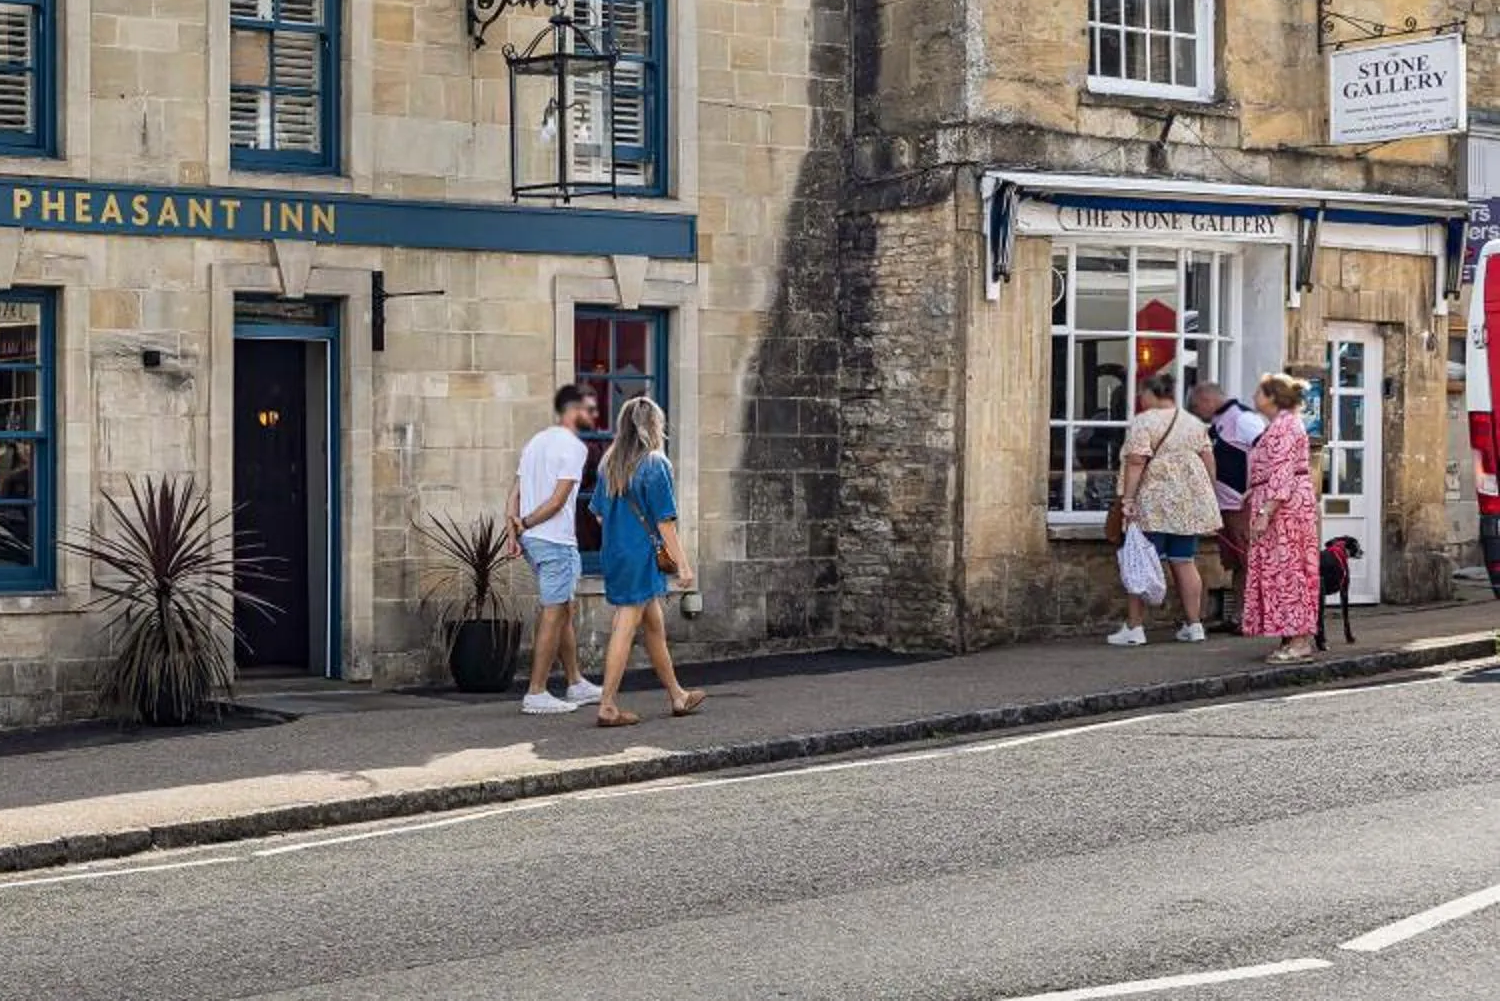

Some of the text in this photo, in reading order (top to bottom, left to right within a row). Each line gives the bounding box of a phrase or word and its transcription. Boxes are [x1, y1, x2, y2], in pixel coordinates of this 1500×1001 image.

[1358, 54, 1430, 80] STONE
[1343, 70, 1448, 100] GALLERY
[12, 187, 241, 230] PHEASANT
[262, 201, 336, 234] INN
[1075, 208, 1279, 234] THE STONE GALLERY
